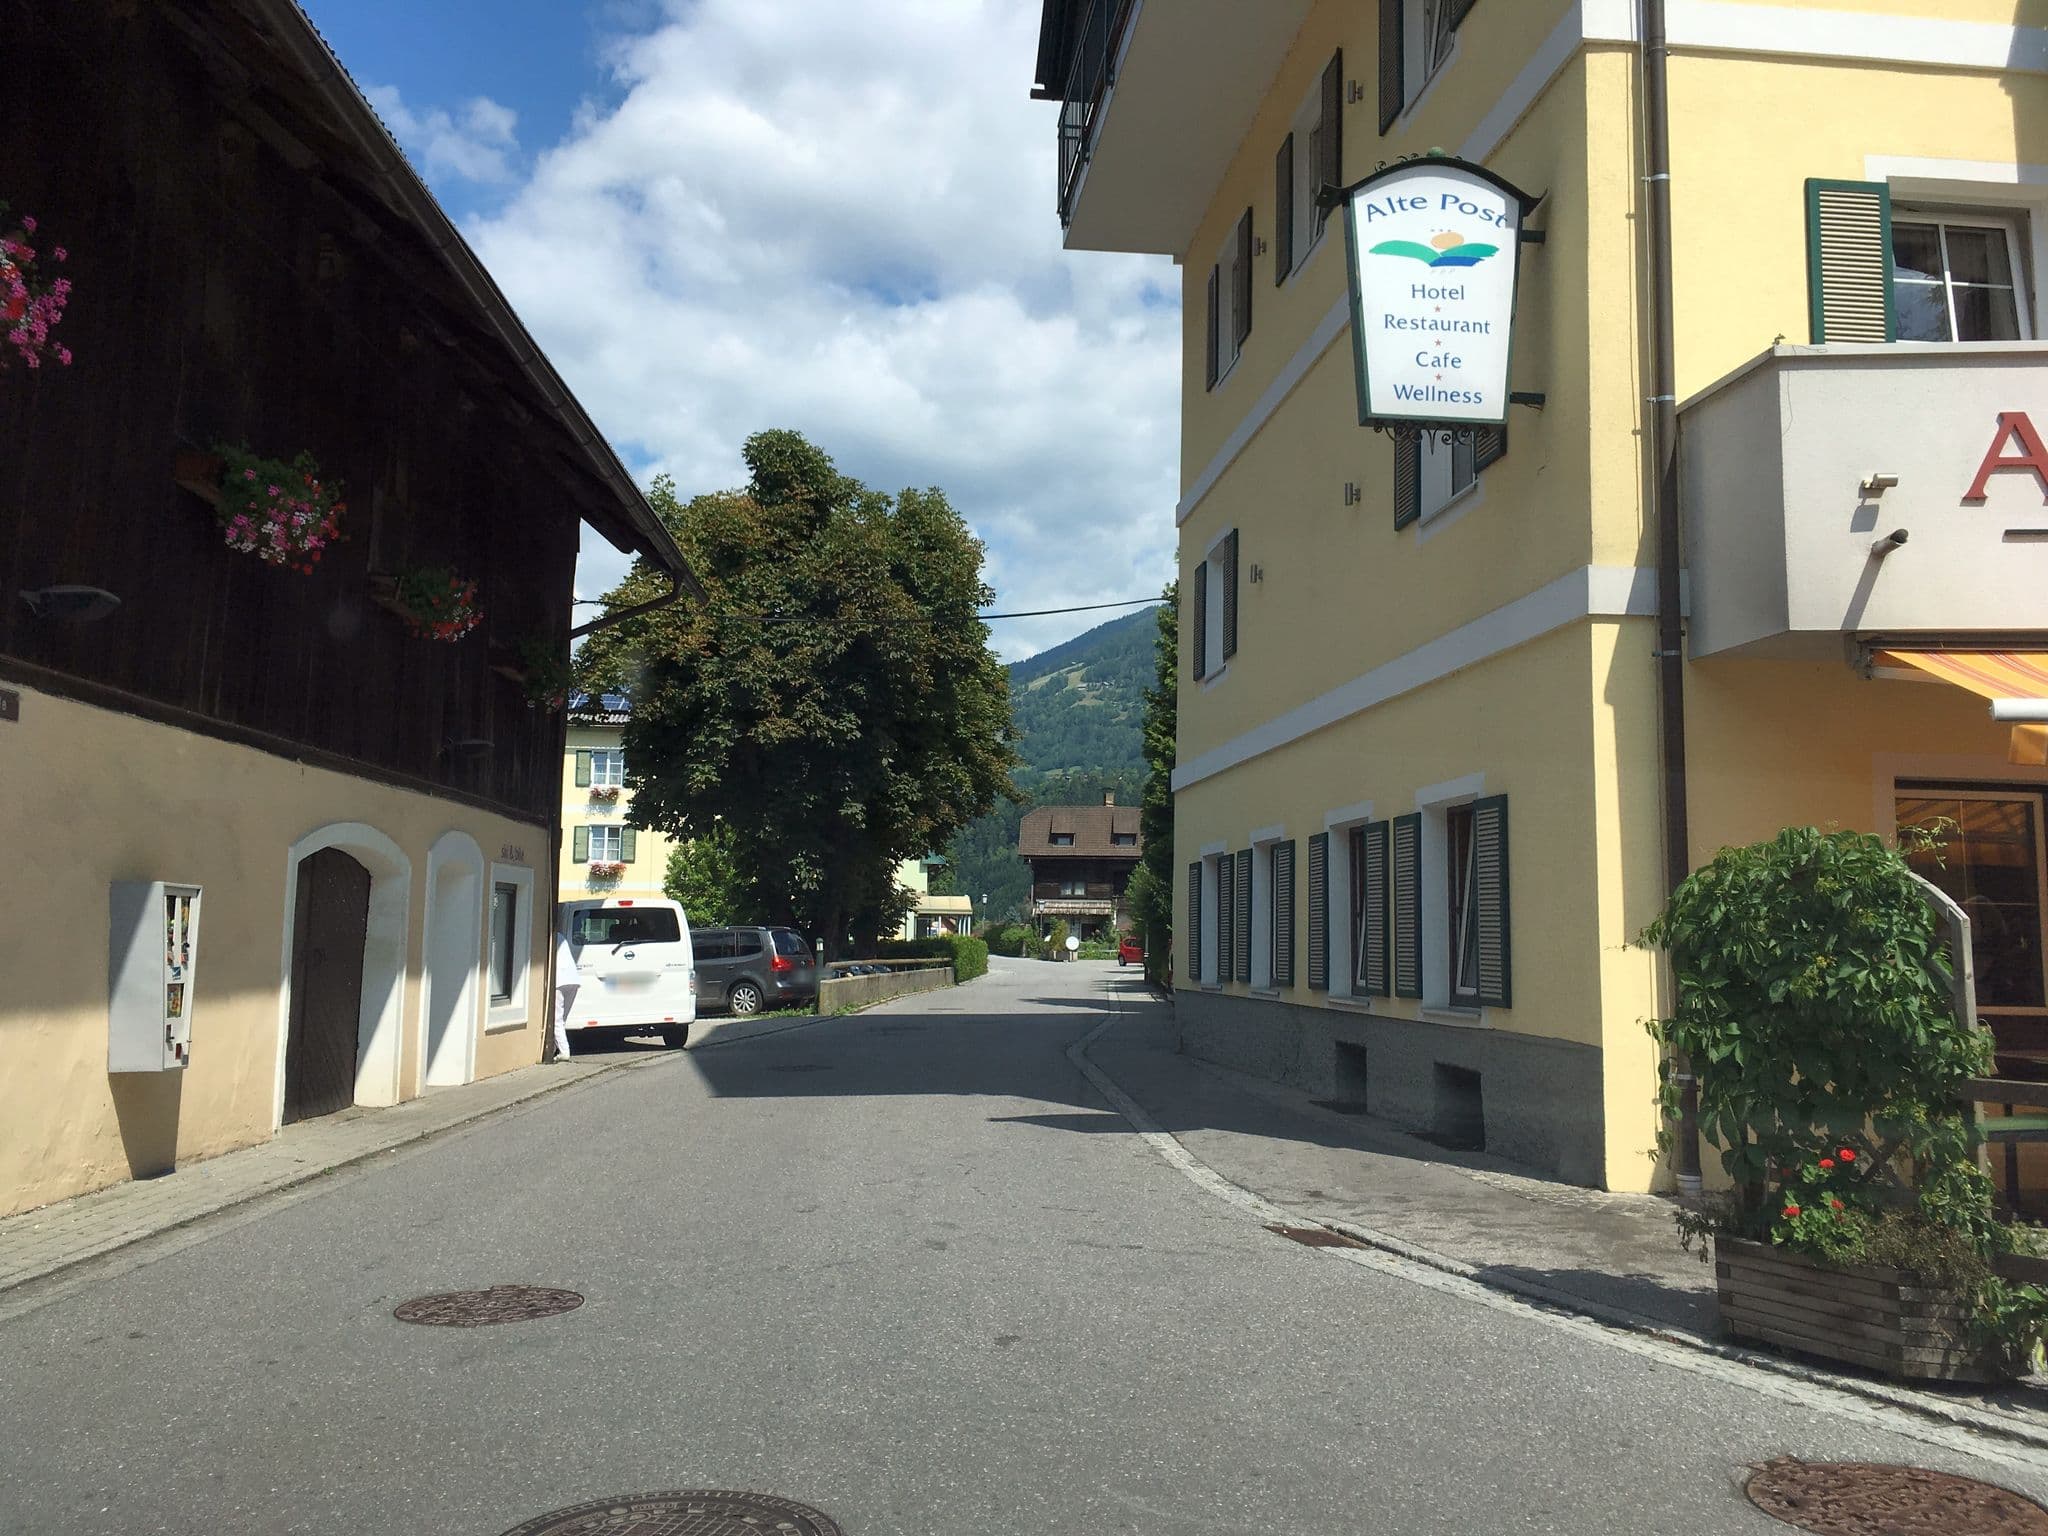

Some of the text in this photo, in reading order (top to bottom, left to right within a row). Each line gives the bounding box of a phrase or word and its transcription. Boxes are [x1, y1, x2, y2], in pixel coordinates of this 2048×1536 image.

[1366, 193, 1508, 229] Alte Post
[1411, 283, 1465, 301] Hotel
[1384, 314, 1491, 334] Restaurant
[1415, 351, 1462, 369] Cafe
[1393, 384, 1483, 404] Wellness
